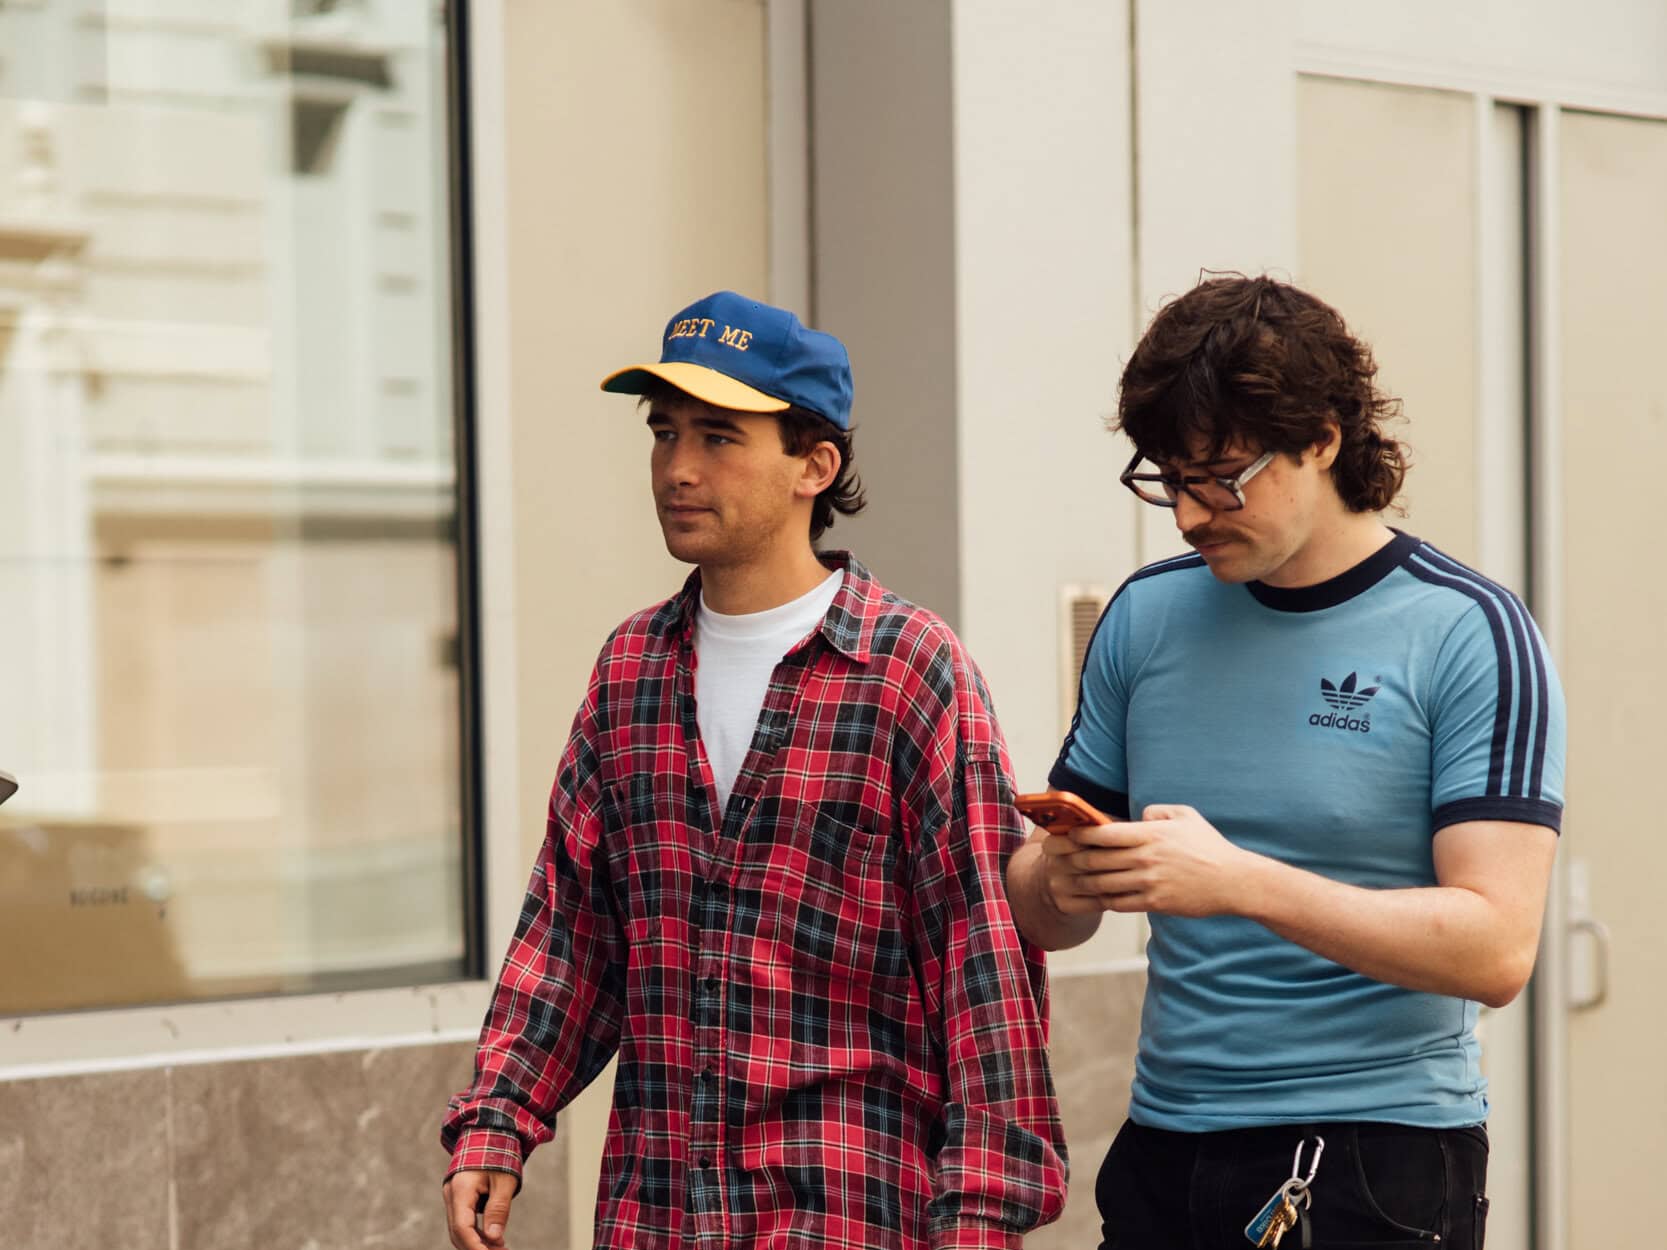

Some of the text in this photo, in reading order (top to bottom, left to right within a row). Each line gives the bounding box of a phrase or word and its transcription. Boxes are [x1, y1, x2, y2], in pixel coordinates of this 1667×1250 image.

[668, 318, 753, 351] MEET ME
[1308, 712, 1371, 733] adidas
